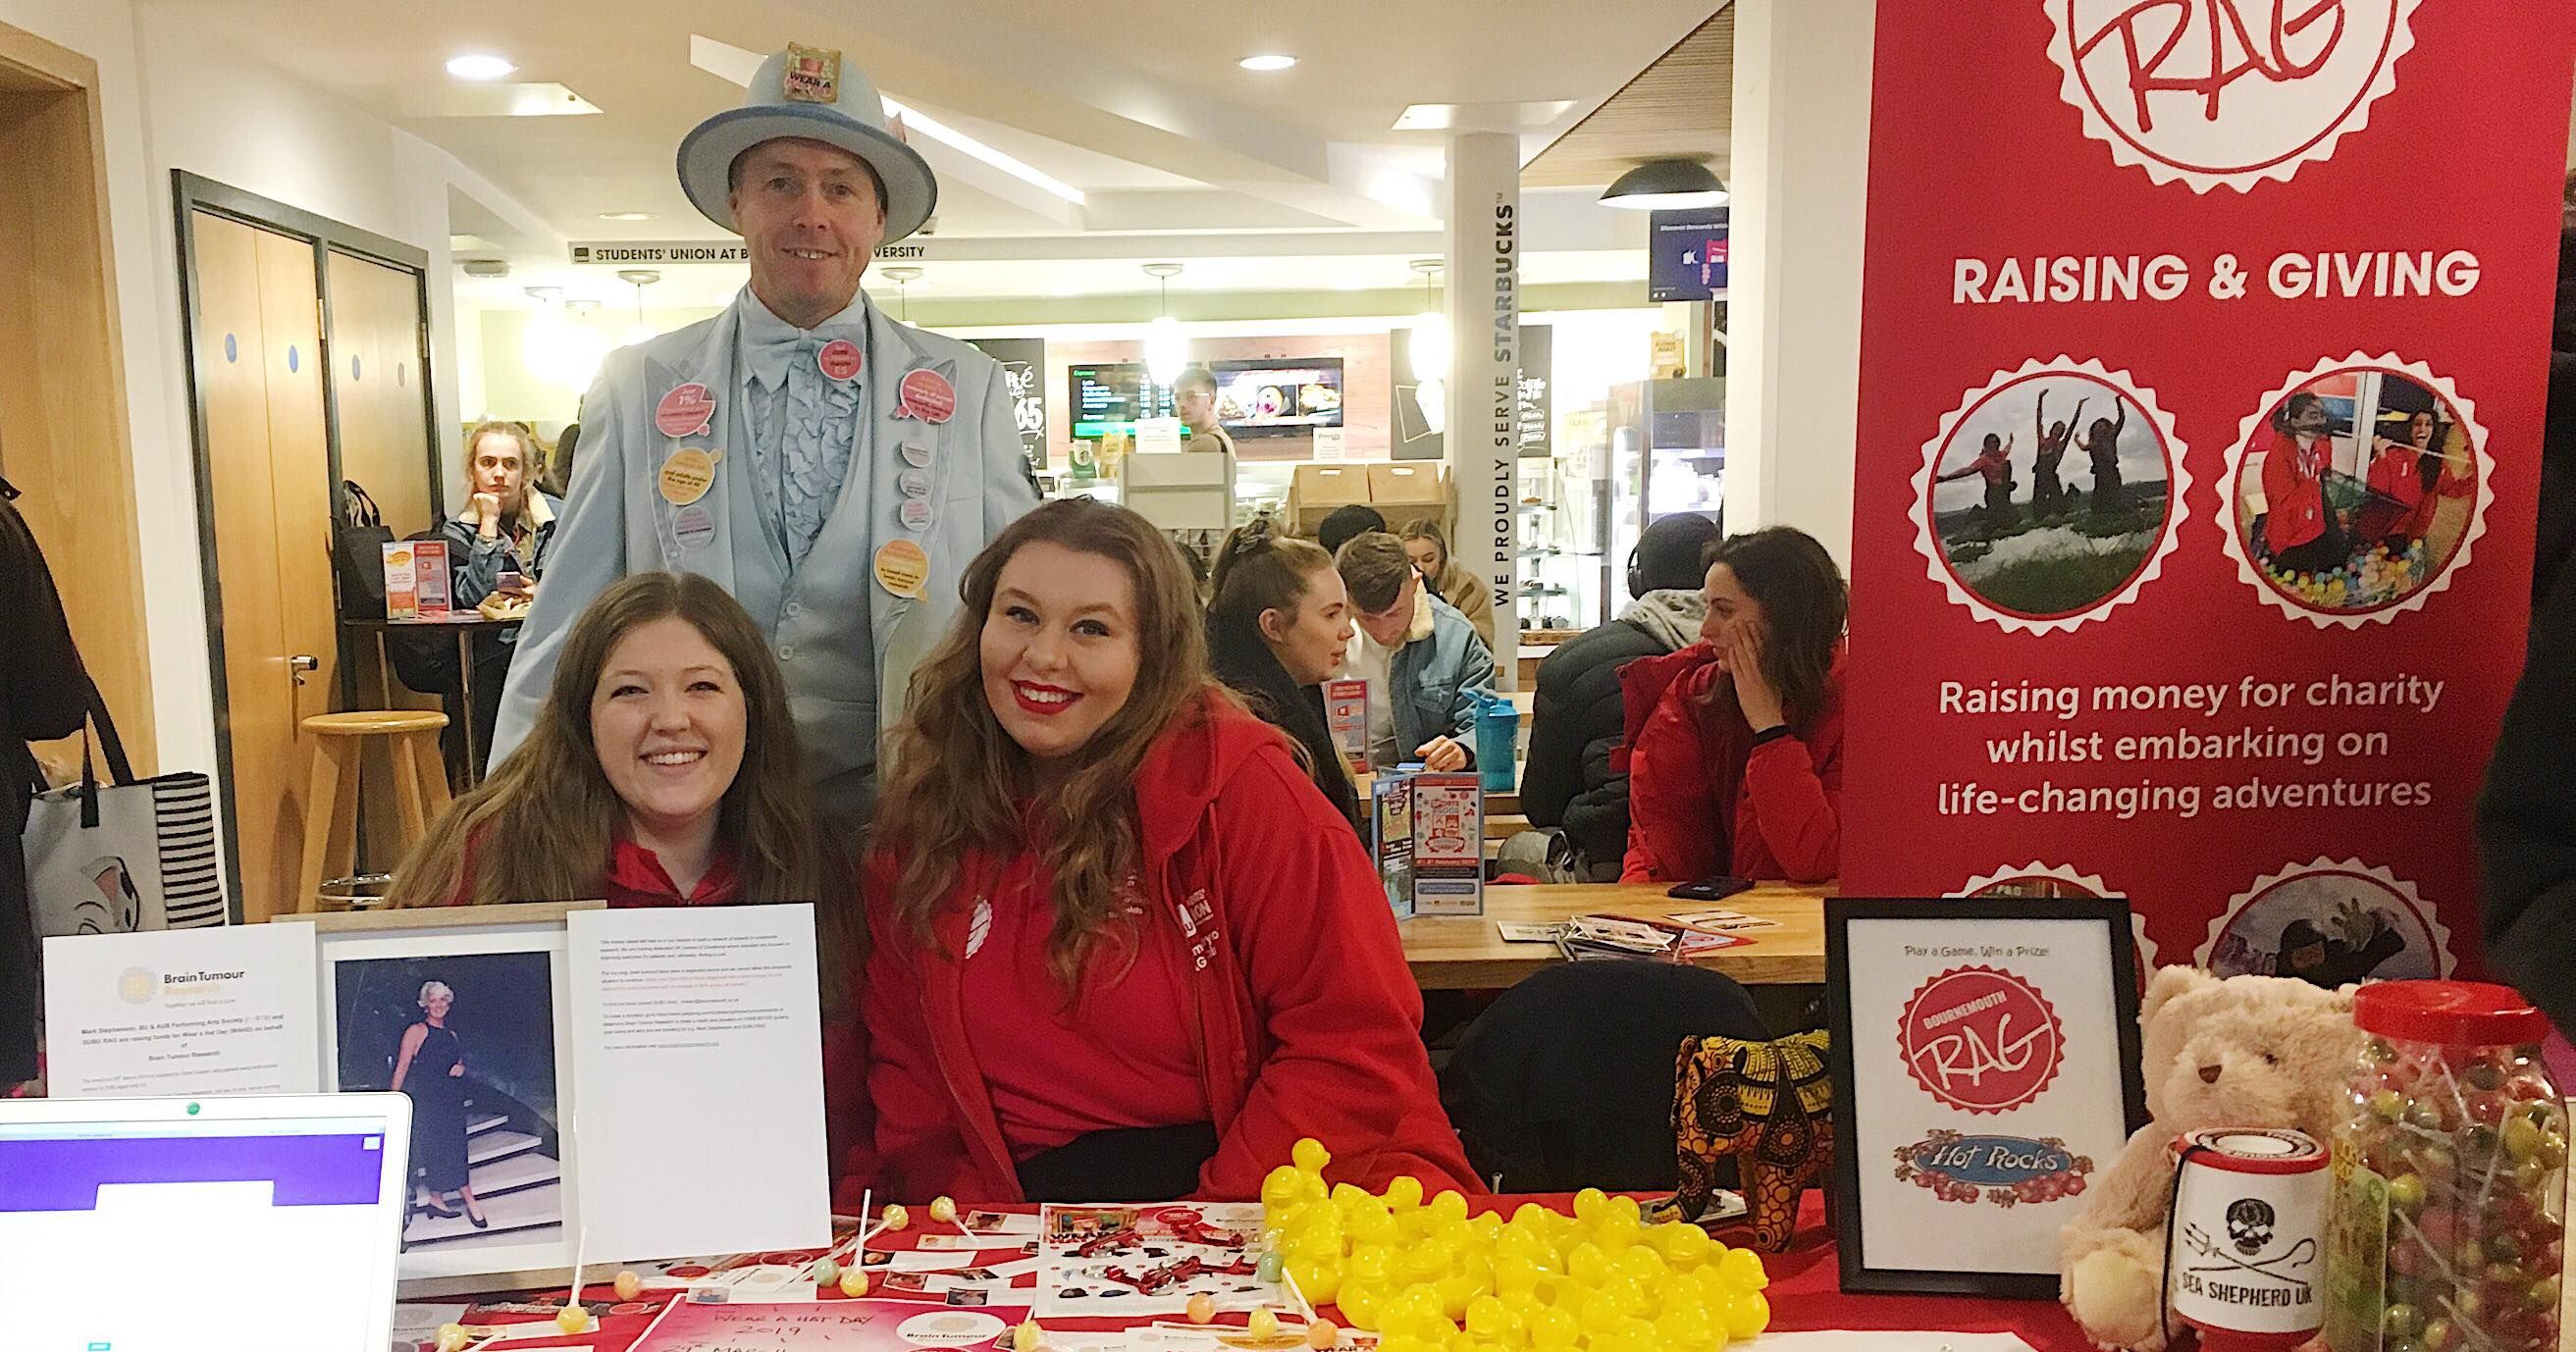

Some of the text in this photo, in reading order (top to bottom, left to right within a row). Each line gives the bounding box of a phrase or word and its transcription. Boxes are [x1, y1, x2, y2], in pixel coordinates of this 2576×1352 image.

[790, 71, 819, 86] WEAR
[596, 248, 665, 260] STUDENTS'
[670, 248, 715, 260] UNION
[719, 248, 735, 259] AT
[1952, 249, 2482, 303] RAISING & GIVING
[1495, 376, 1509, 446] SERVE
[1495, 459, 1509, 562] PROUDLY
[1495, 574, 1509, 606] WE
[1939, 673, 2445, 719] Raising money for charity
[1986, 727, 2390, 764] whilst embarking on
[1937, 778, 2432, 819] life-changing adventures
[1904, 945, 1928, 958] Play
[1980, 945, 2003, 958] Win
[2006, 948, 2013, 957] a
[164, 970, 244, 984] Brain Tumour
[1922, 990, 2007, 1030] BOURNEMOUTH
[1916, 1013, 2052, 1091] RAG
[1930, 1143, 2060, 1171] Hot Rocks
[2182, 1272, 2313, 1307] SEA SHEPHERD UK
